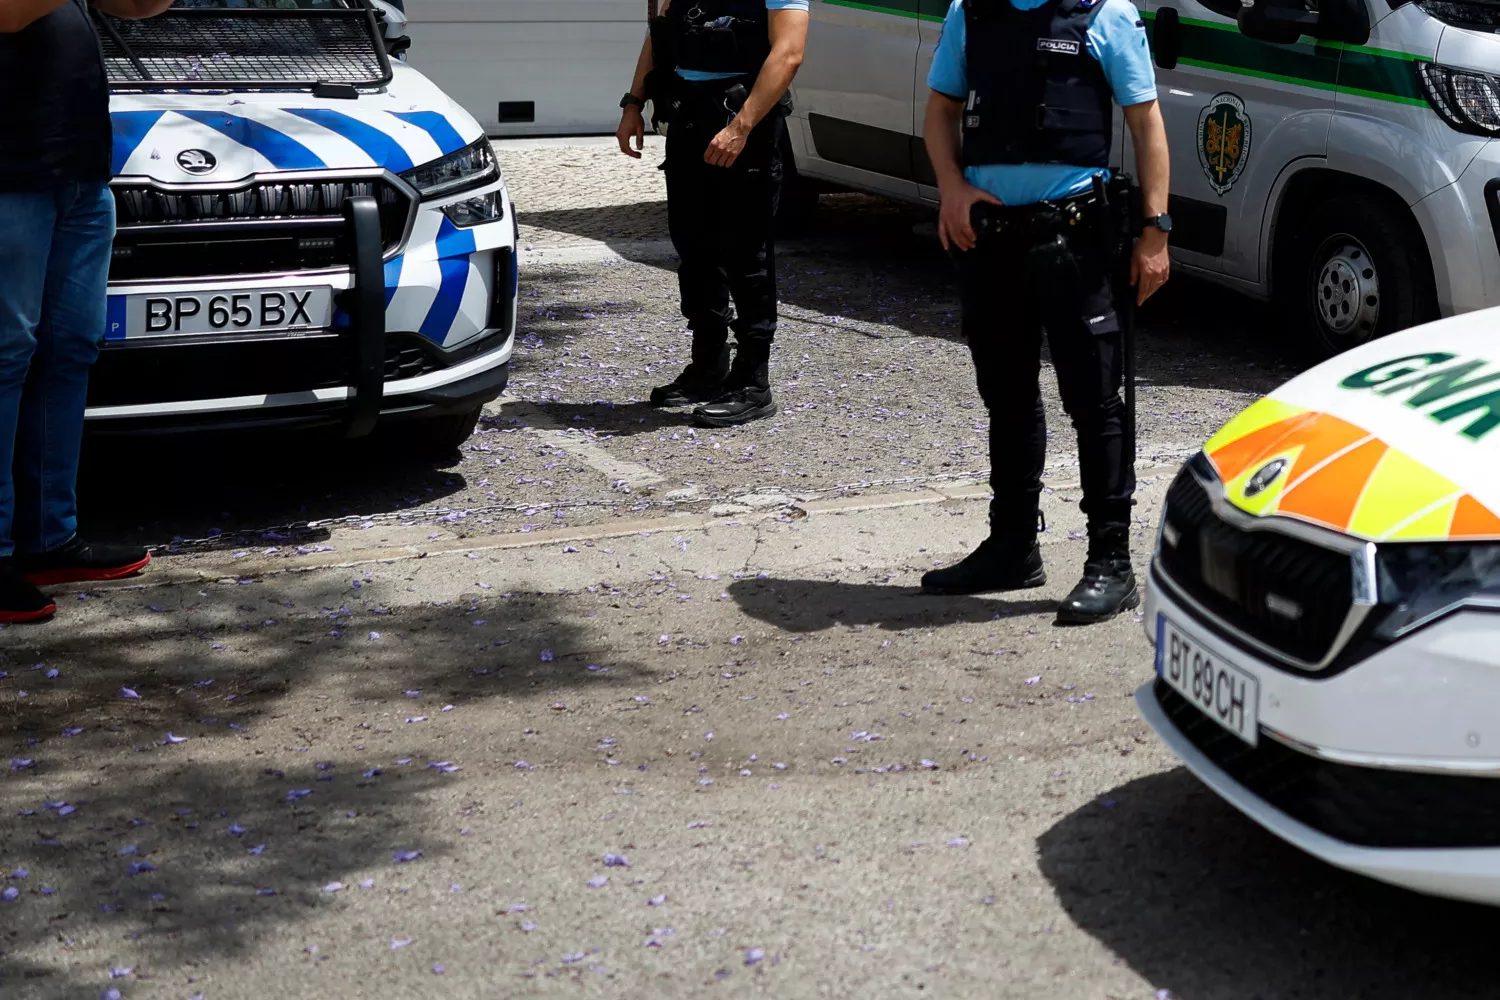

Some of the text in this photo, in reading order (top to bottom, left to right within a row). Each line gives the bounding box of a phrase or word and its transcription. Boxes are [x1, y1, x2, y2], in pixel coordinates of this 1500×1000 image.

[1040, 41, 1076, 51] POLÍCIA
[145, 296, 201, 332] BP
[208, 293, 252, 328] 65
[260, 290, 313, 326] BX
[1170, 632, 1246, 733] BT 89 CH
